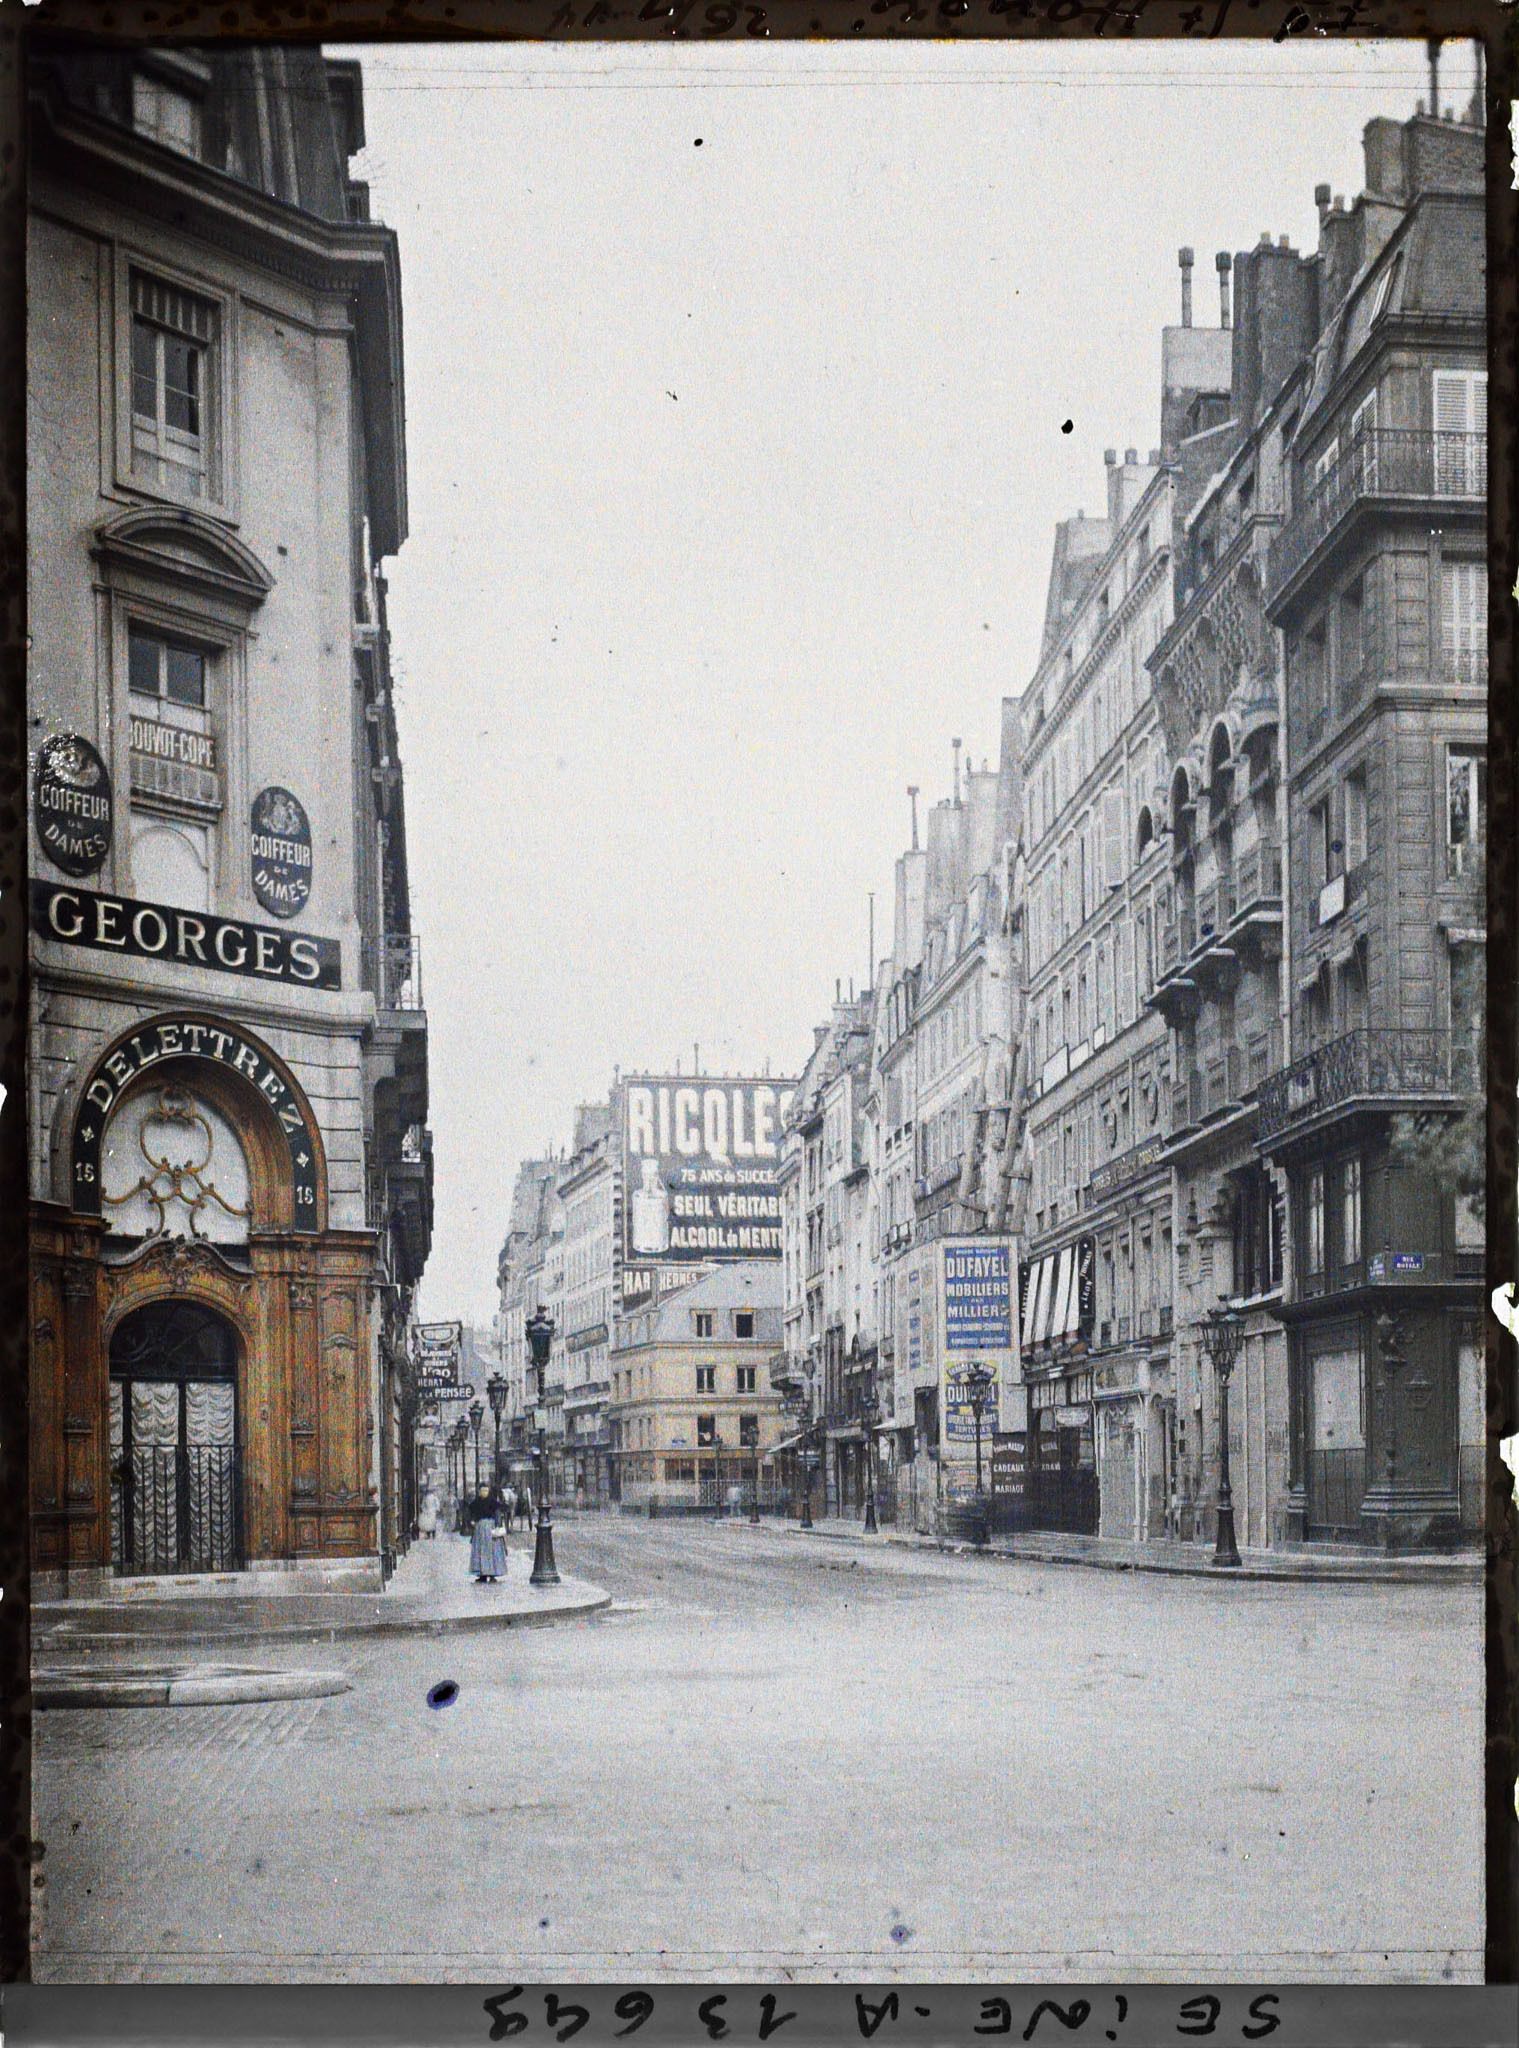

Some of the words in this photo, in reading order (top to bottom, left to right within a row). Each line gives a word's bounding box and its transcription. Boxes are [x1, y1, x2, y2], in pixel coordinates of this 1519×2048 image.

[40, 784, 109, 821] COIFFEUR
[45, 824, 107, 858] DAMES
[251, 834, 311, 867] COIFFEUR
[255, 870, 309, 901] DAMES
[49, 891, 320, 980] GEORGES
[87, 1024, 304, 1134] DELETTREZ
[75, 1162, 95, 1182] 15
[680, 1169, 697, 1183] 75
[699, 1168, 723, 1184] ANS
[297, 1186, 315, 1205] 15
[674, 1195, 714, 1217] SEUL
[670, 1226, 727, 1249] ALCOOL
[946, 1257, 1009, 1279] DUFAYEL
[946, 1283, 1009, 1297] MOBILIERS
[993, 1463, 1025, 1473] CADEAUX
[995, 1484, 1025, 1494] MARIAGE
